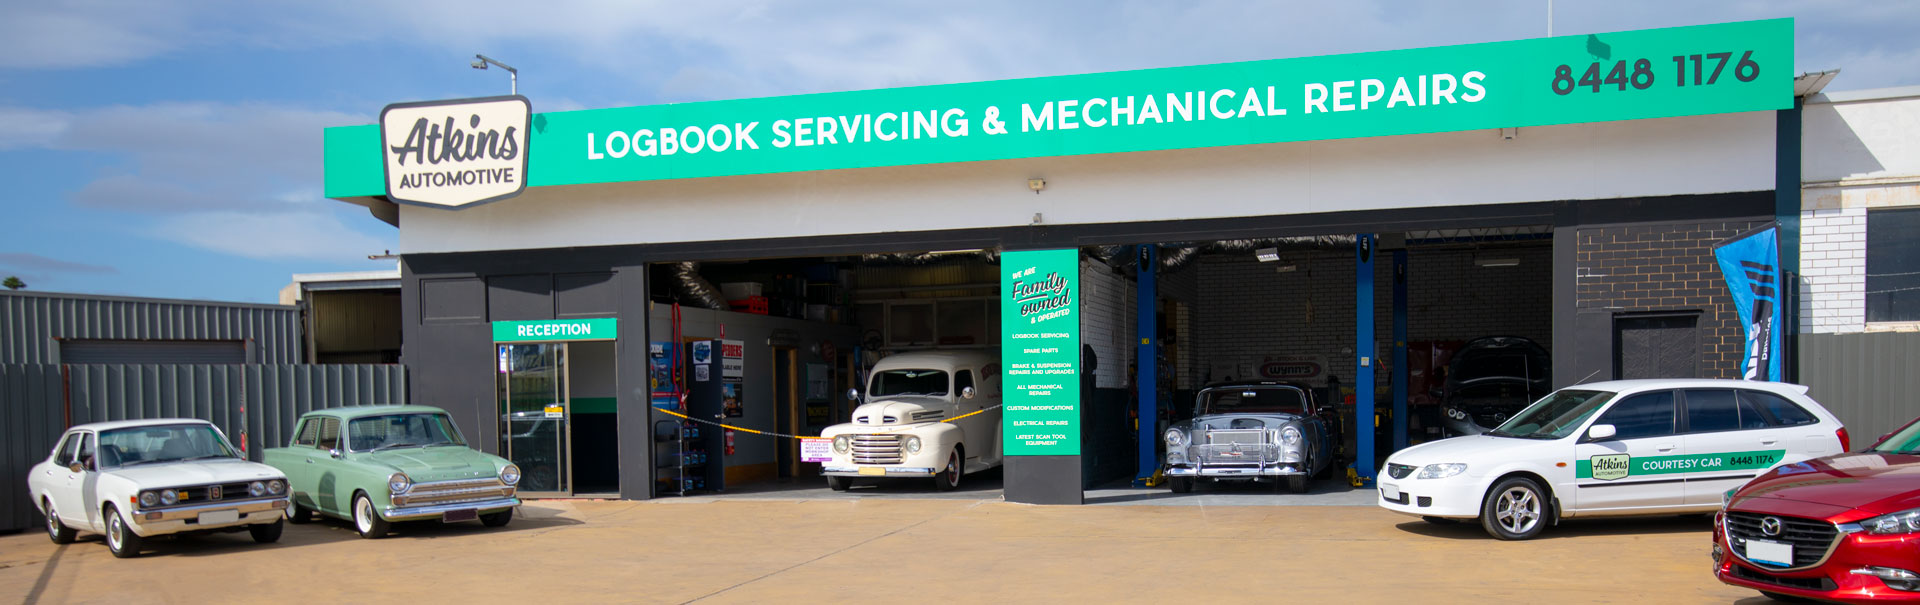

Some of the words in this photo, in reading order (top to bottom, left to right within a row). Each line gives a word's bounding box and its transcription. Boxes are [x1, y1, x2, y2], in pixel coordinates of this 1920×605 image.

[1551, 57, 1655, 97] 8448
[1673, 50, 1761, 88] 1176
[587, 121, 760, 160] LOGBOOK
[771, 107, 969, 148] SERVICING
[982, 105, 1009, 136] &
[1021, 86, 1287, 133] MECHANICAL
[1304, 71, 1486, 114] REPAIRS
[390, 114, 518, 166] Atkins
[399, 168, 514, 189] AUTOMOTIVE
[1012, 271, 1022, 279] WE
[1024, 267, 1036, 276] ARE
[1012, 272, 1068, 300] Family
[1021, 288, 1071, 317] owned
[1038, 309, 1070, 322] OPERATED
[517, 323, 591, 337] RECEPTION
[1594, 457, 1627, 470] Atkins
[1642, 459, 1698, 470] COURTESY
[1700, 458, 1722, 467] CAR
[1730, 456, 1753, 465] 8448
[1755, 455, 1774, 464] 1176
